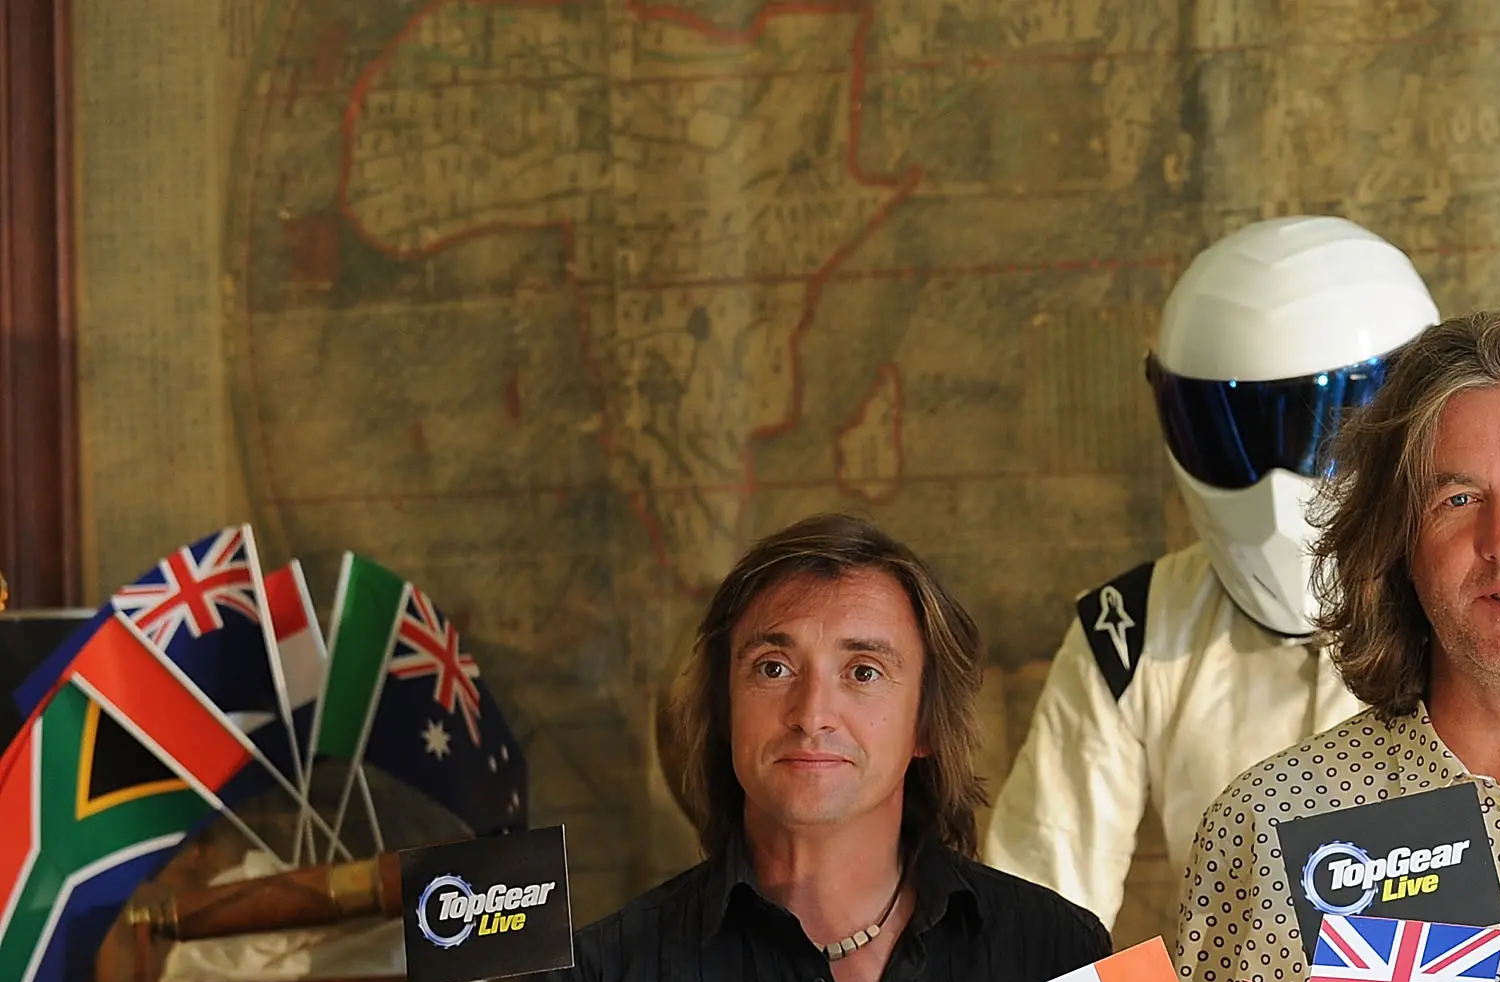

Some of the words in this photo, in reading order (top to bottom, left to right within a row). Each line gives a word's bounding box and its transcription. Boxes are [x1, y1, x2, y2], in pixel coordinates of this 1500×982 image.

[1328, 839, 1471, 890] TopGear
[438, 881, 556, 923] TopGear
[1382, 873, 1439, 902] Live
[478, 911, 526, 936] Live
